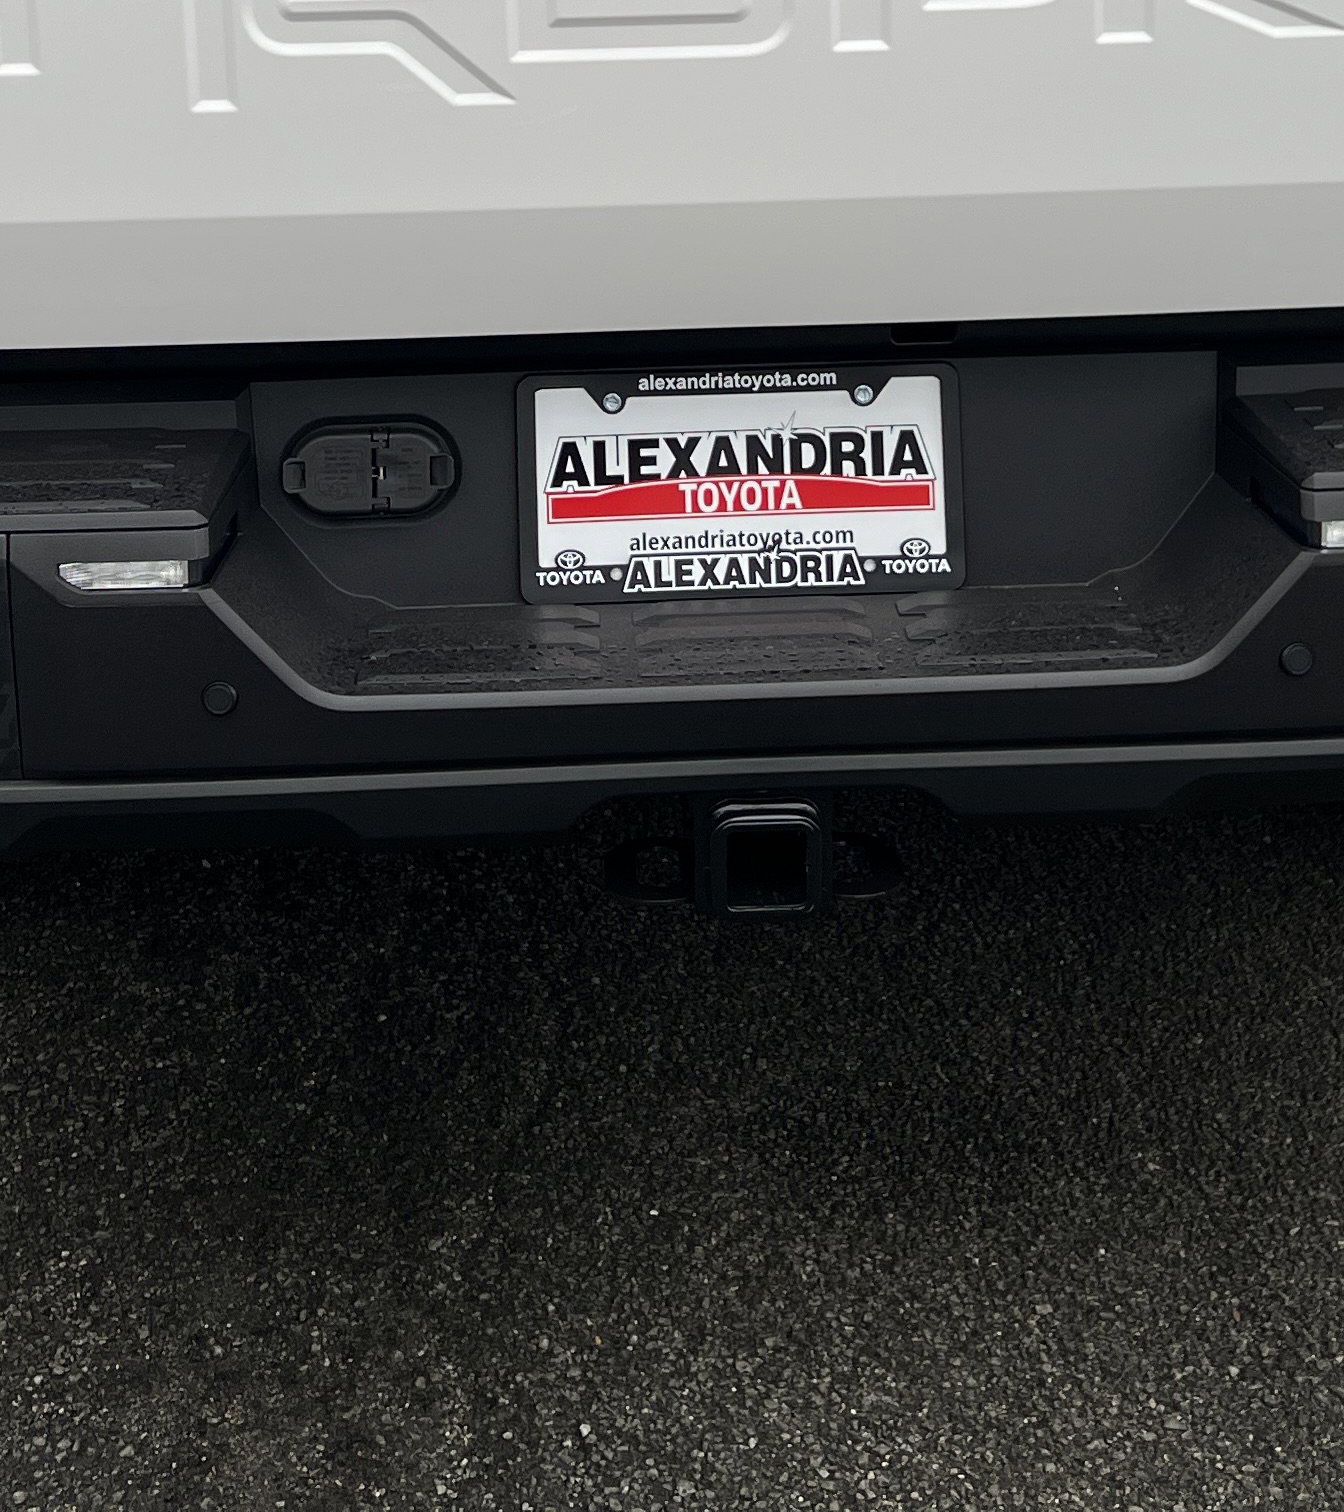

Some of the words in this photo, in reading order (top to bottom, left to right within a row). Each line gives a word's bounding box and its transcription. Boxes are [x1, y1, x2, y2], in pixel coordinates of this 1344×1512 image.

[637, 370, 837, 391] alexandriatoyota.com
[549, 428, 930, 488] ALEXANDRIA
[679, 479, 804, 513] TOYOTA
[629, 527, 855, 552] alexandriatoyota.com
[536, 570, 606, 587] TOYOTA
[627, 549, 863, 592] ALEXANDRIA
[881, 558, 952, 575] TOYOTA
